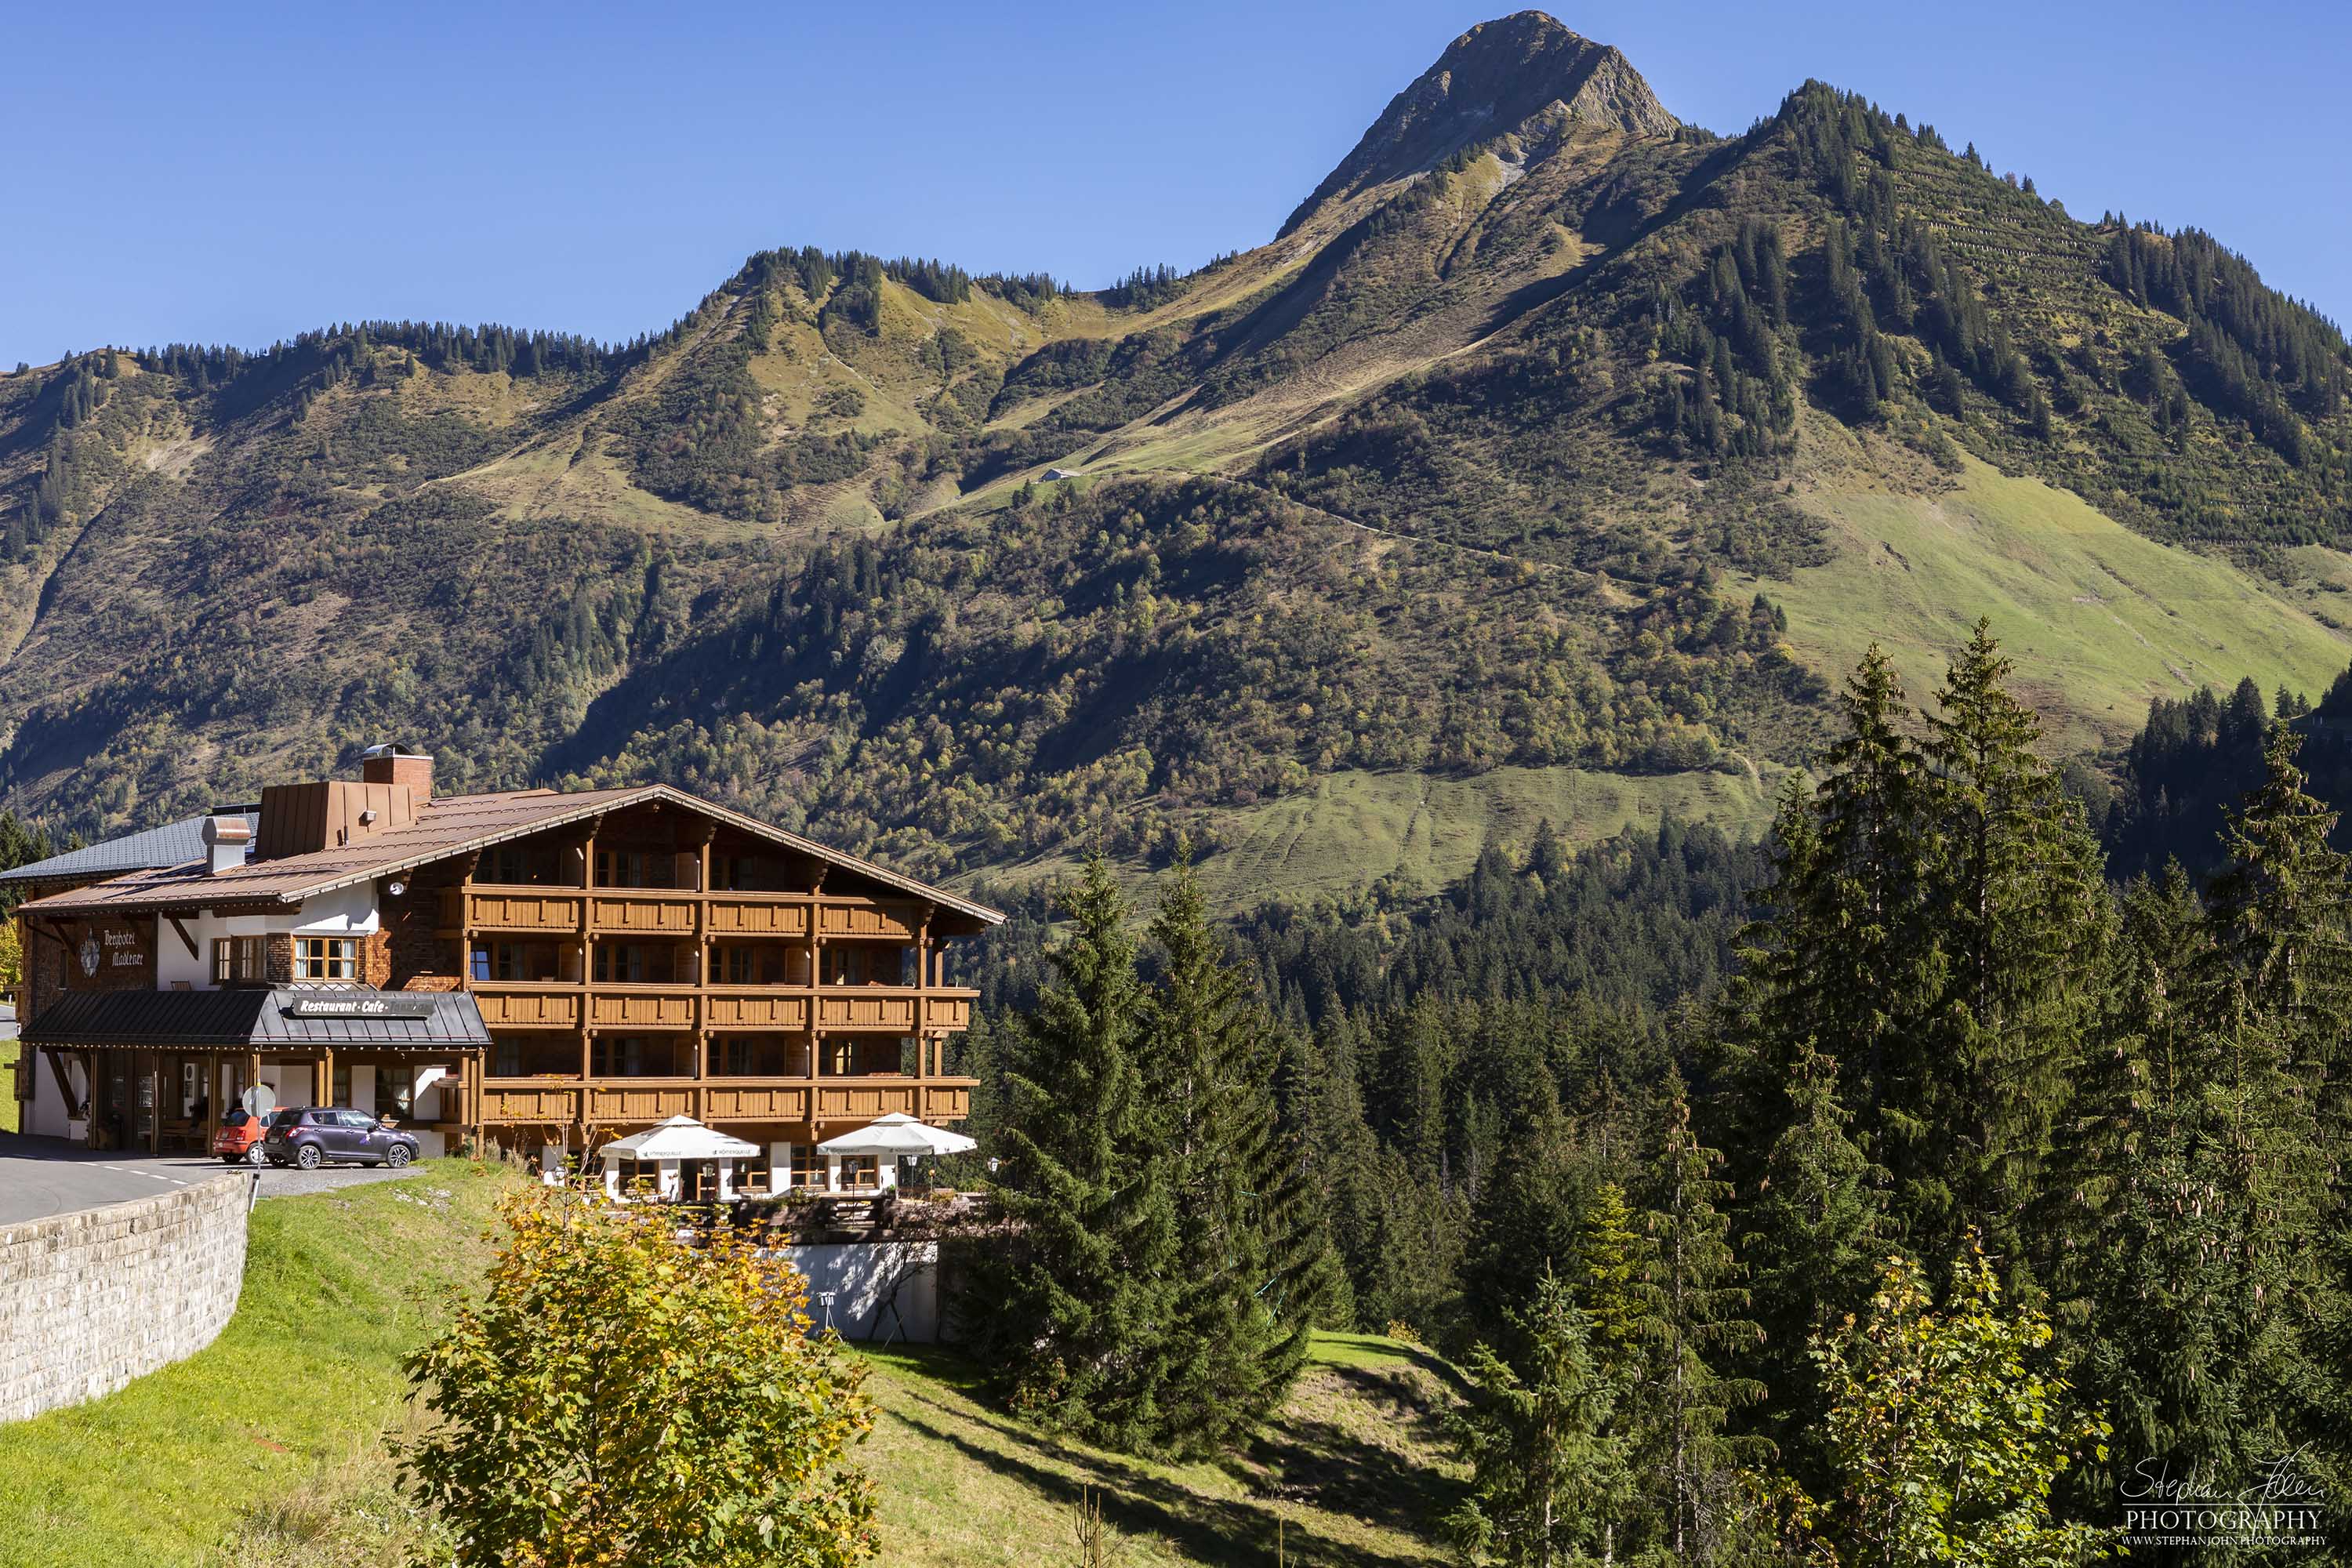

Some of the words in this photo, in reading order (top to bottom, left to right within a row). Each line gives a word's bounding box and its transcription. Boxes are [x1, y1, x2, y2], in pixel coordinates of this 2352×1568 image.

[104, 930, 136, 949] Berghotel
[112, 950, 143, 966] Madlener
[300, 1000, 357, 1012] Restaurant
[361, 1000, 384, 1013] Cafe
